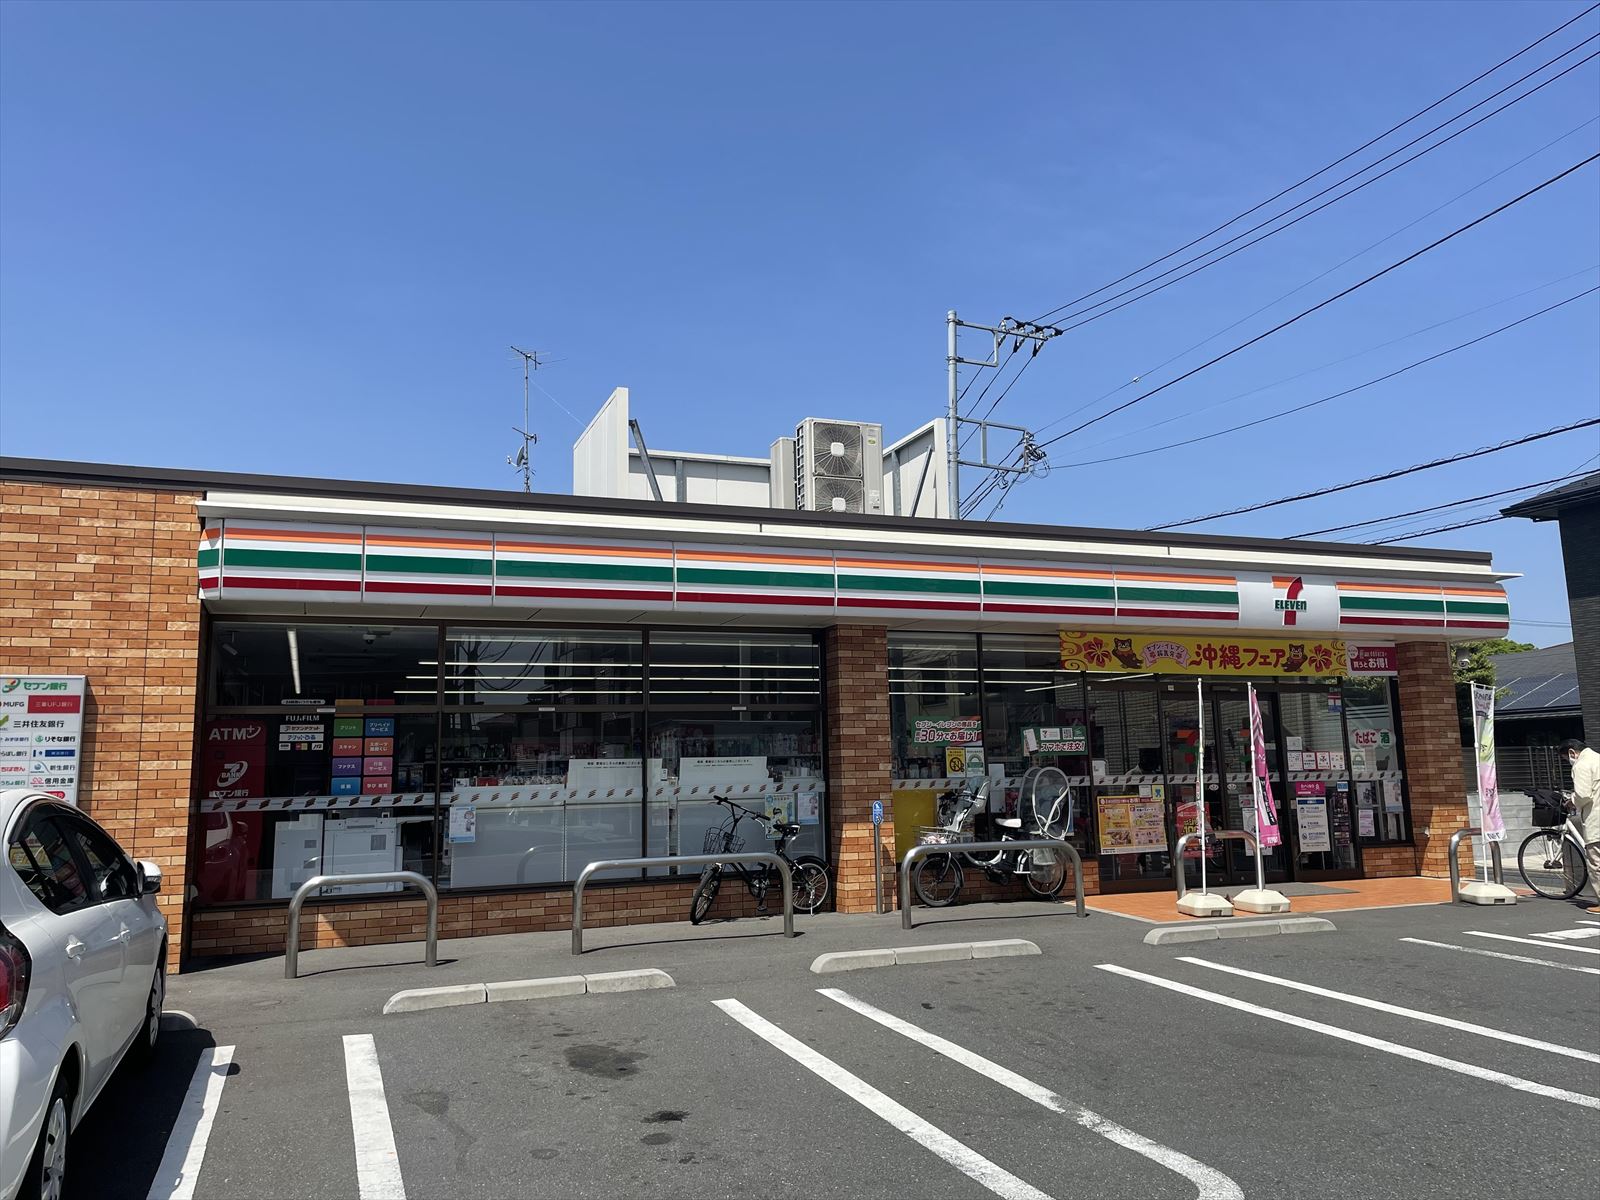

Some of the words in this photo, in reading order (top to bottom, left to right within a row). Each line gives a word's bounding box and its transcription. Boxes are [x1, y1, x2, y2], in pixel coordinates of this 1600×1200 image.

[1188, 643, 1286, 670] 沖縄フェア
[23, 682, 68, 691] セブン銀行
[13, 720, 65, 728] 三井住友銀行
[1355, 731, 1377, 744] たばこ
[1380, 732, 1390, 744] 酒
[45, 777, 75, 785] 信用金庫
